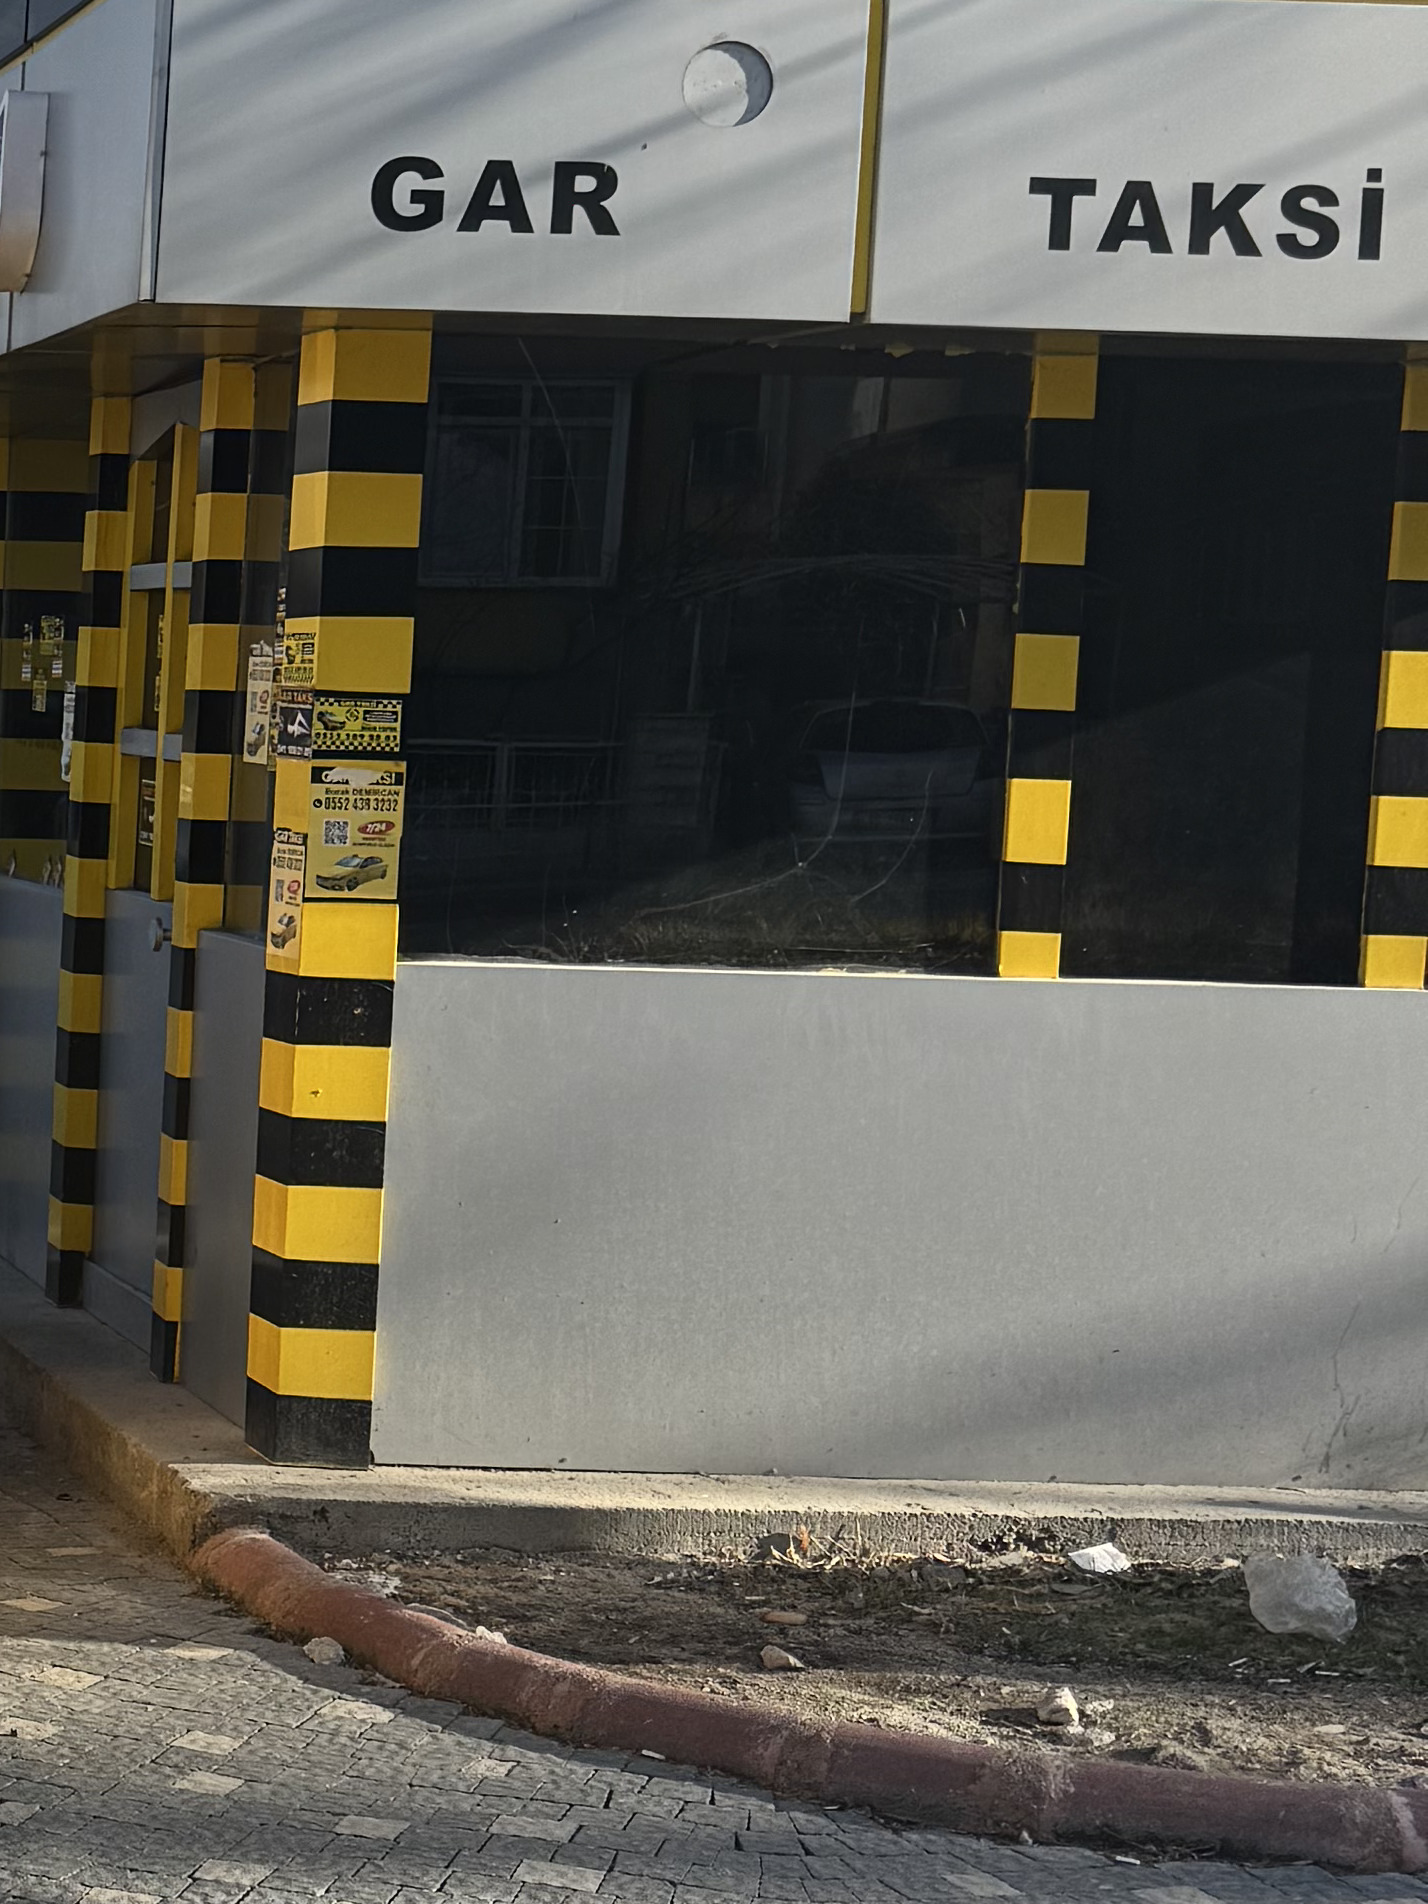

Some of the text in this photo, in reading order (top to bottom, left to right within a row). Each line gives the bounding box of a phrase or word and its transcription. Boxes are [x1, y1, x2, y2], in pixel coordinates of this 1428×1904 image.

[370, 154, 1386, 261] GAR TAKSİ
[324, 797, 350, 811] 0552
[373, 797, 399, 812] 3232
